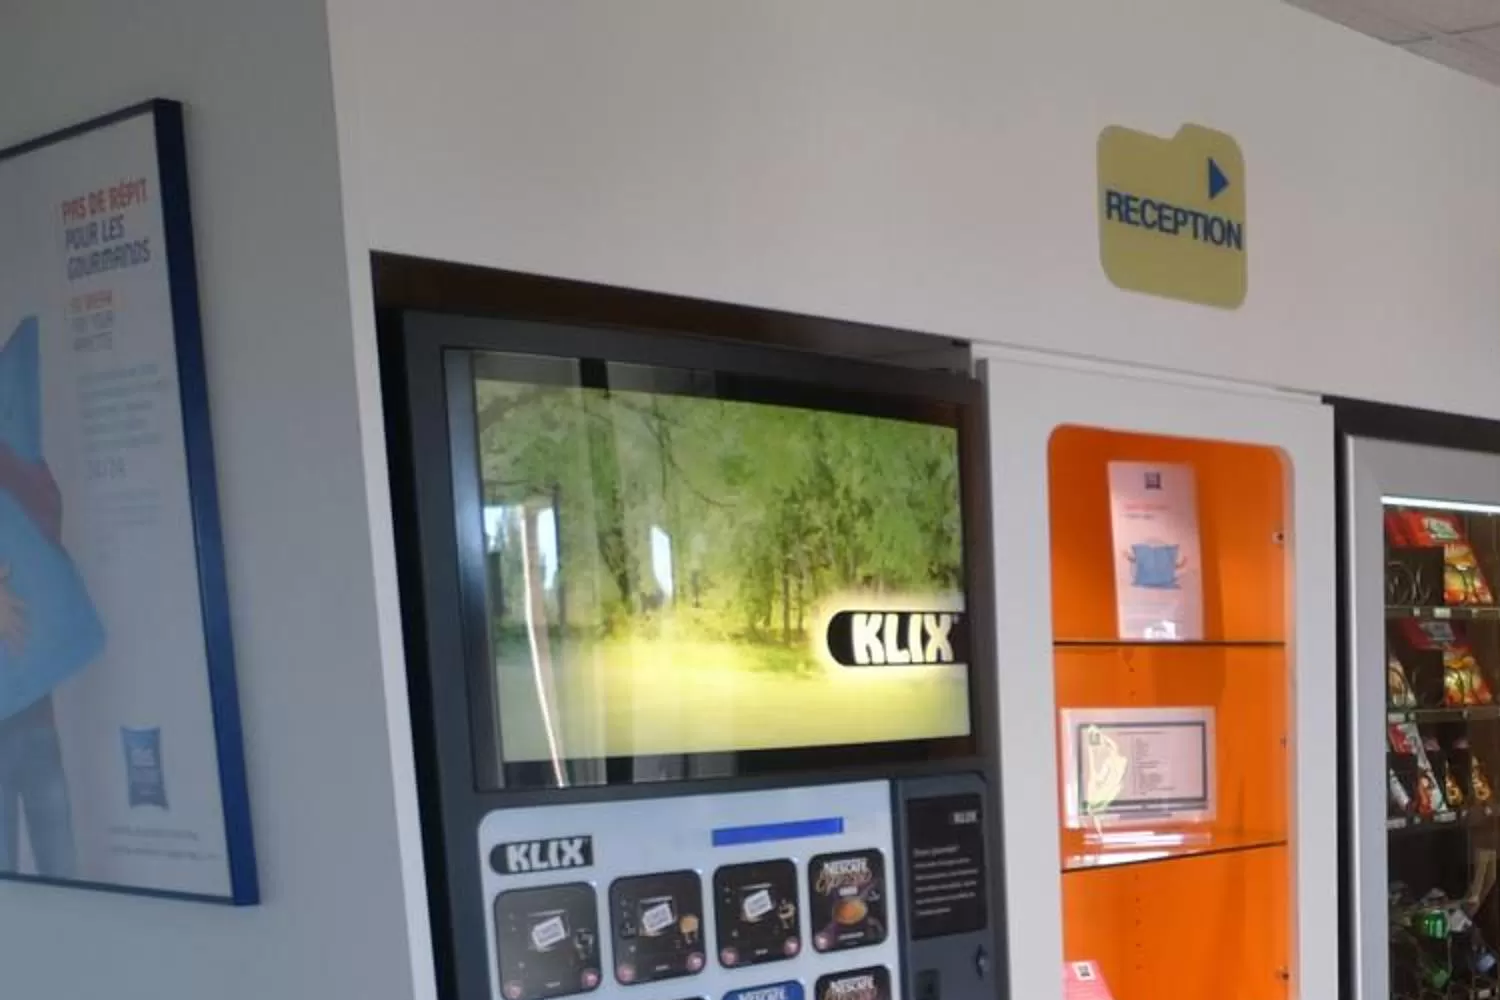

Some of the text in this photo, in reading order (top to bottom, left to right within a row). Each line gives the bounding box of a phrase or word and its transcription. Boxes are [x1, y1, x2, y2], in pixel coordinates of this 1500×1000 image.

[87, 189, 107, 214] DE
[101, 213, 125, 242] LES
[1105, 190, 1243, 251] RECEPTION
[851, 612, 955, 665] KLIX
[506, 837, 585, 872] KLIX
